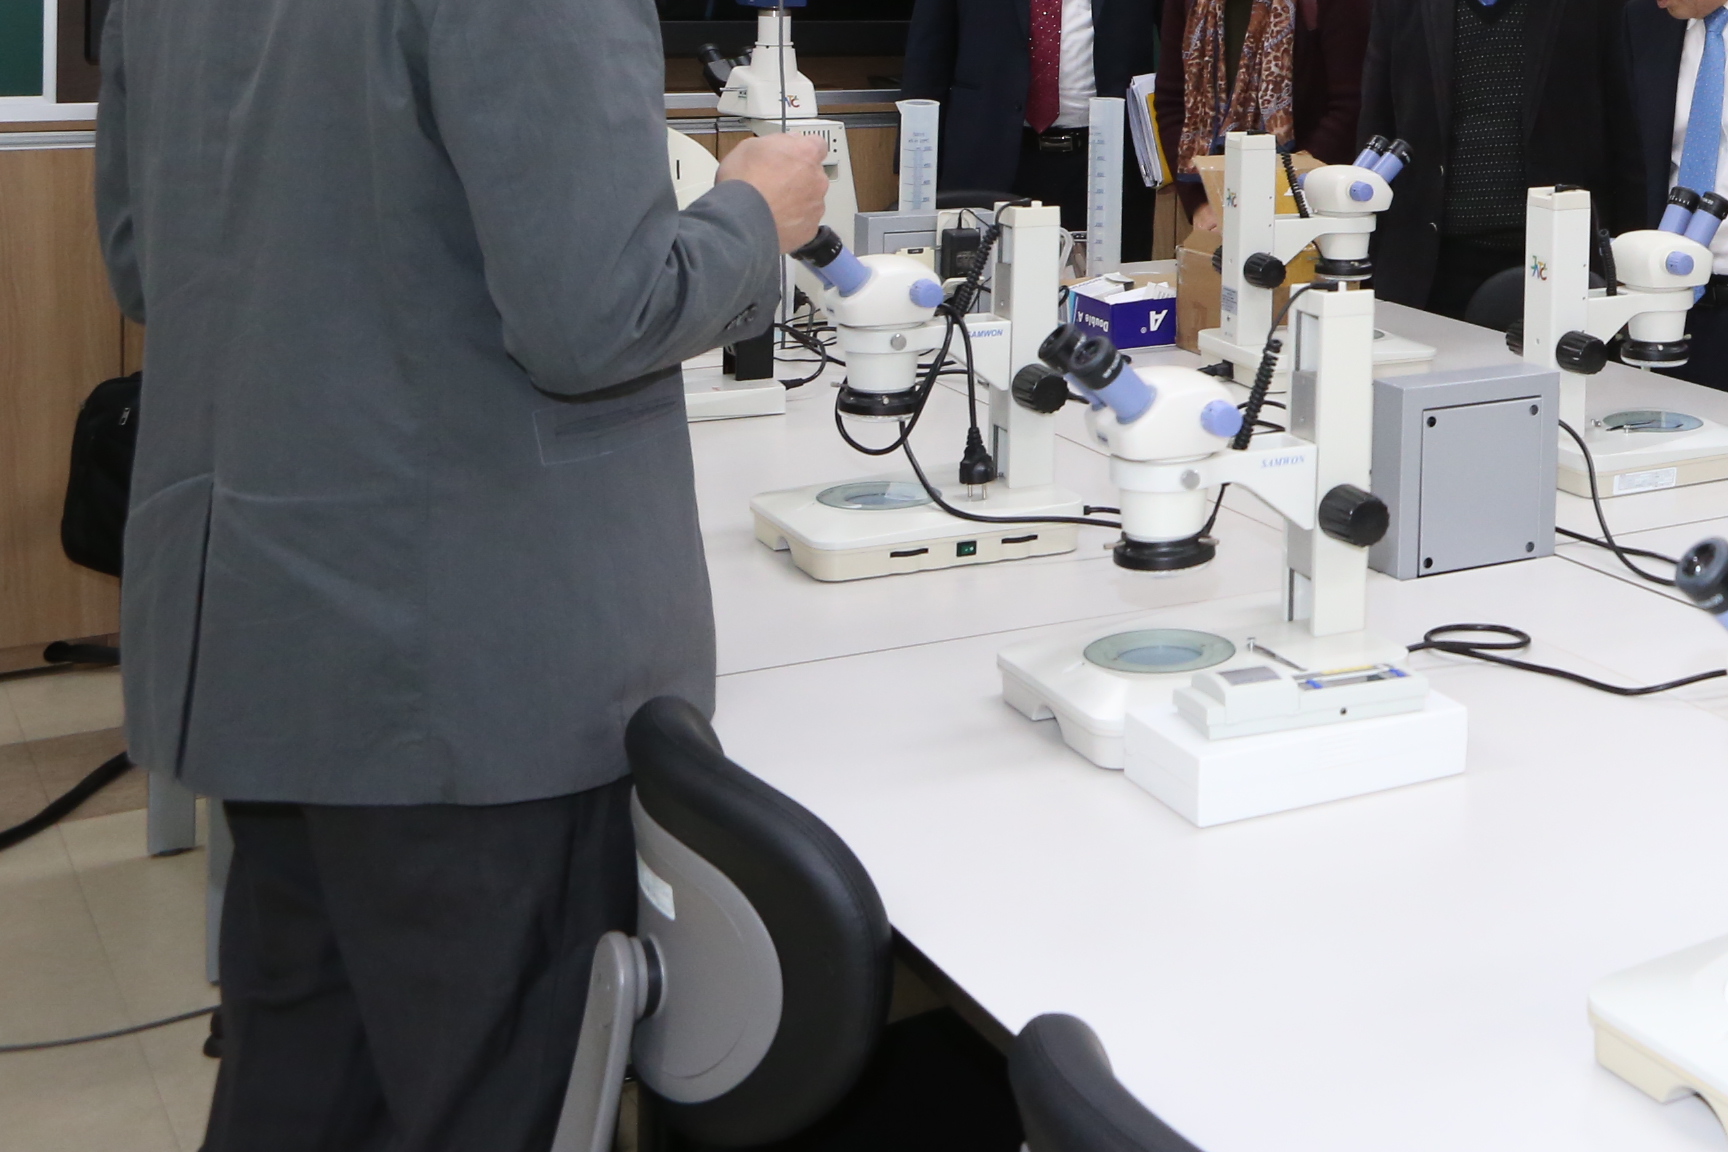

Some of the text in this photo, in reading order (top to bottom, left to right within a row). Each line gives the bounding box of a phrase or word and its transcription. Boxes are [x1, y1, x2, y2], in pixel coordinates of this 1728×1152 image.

[1077, 311, 1109, 332] Double A
[1149, 310, 1168, 332] A
